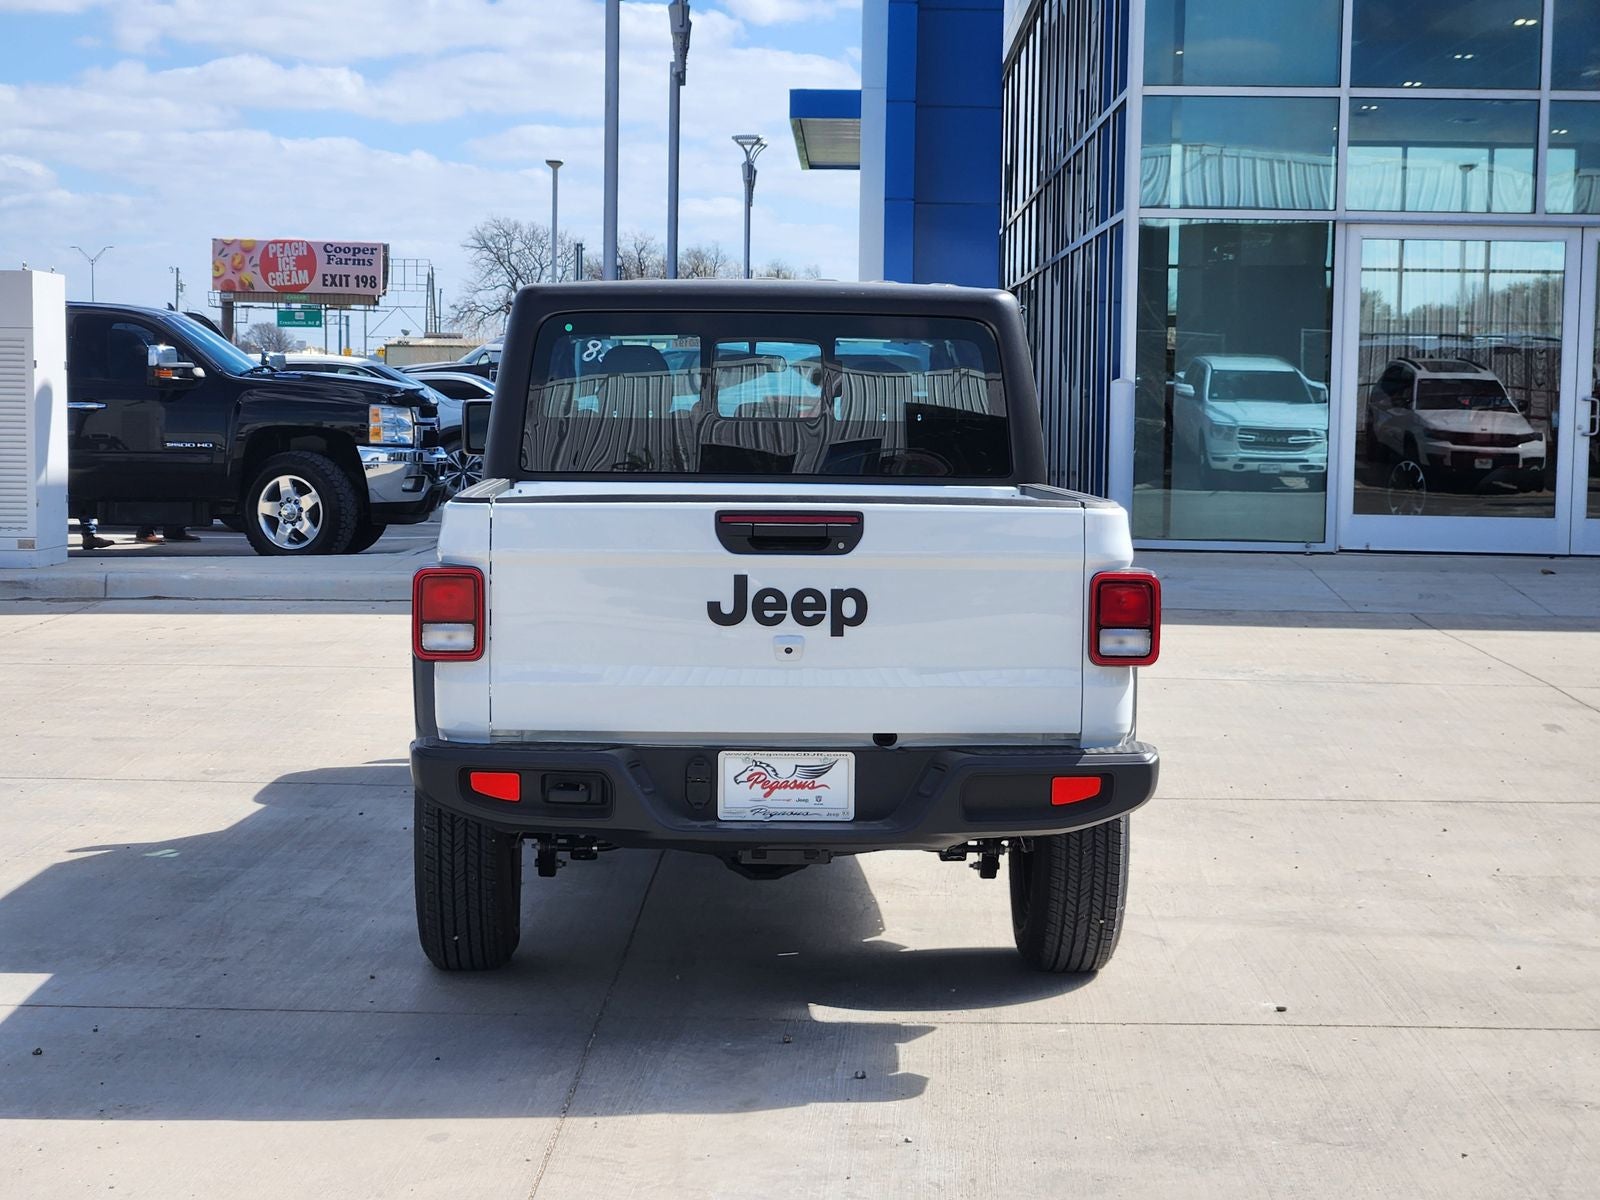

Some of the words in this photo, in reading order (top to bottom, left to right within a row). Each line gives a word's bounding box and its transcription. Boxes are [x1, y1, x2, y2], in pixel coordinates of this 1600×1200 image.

[268, 242, 308, 258] PEACH
[323, 243, 377, 257] Cooper
[277, 257, 297, 272] ICE
[326, 254, 373, 267] Farms
[267, 271, 309, 287] CREAM
[322, 274, 350, 288] EXIT
[354, 274, 377, 289] 198
[707, 574, 868, 637] Jeep
[746, 771, 830, 799] Pegasus
